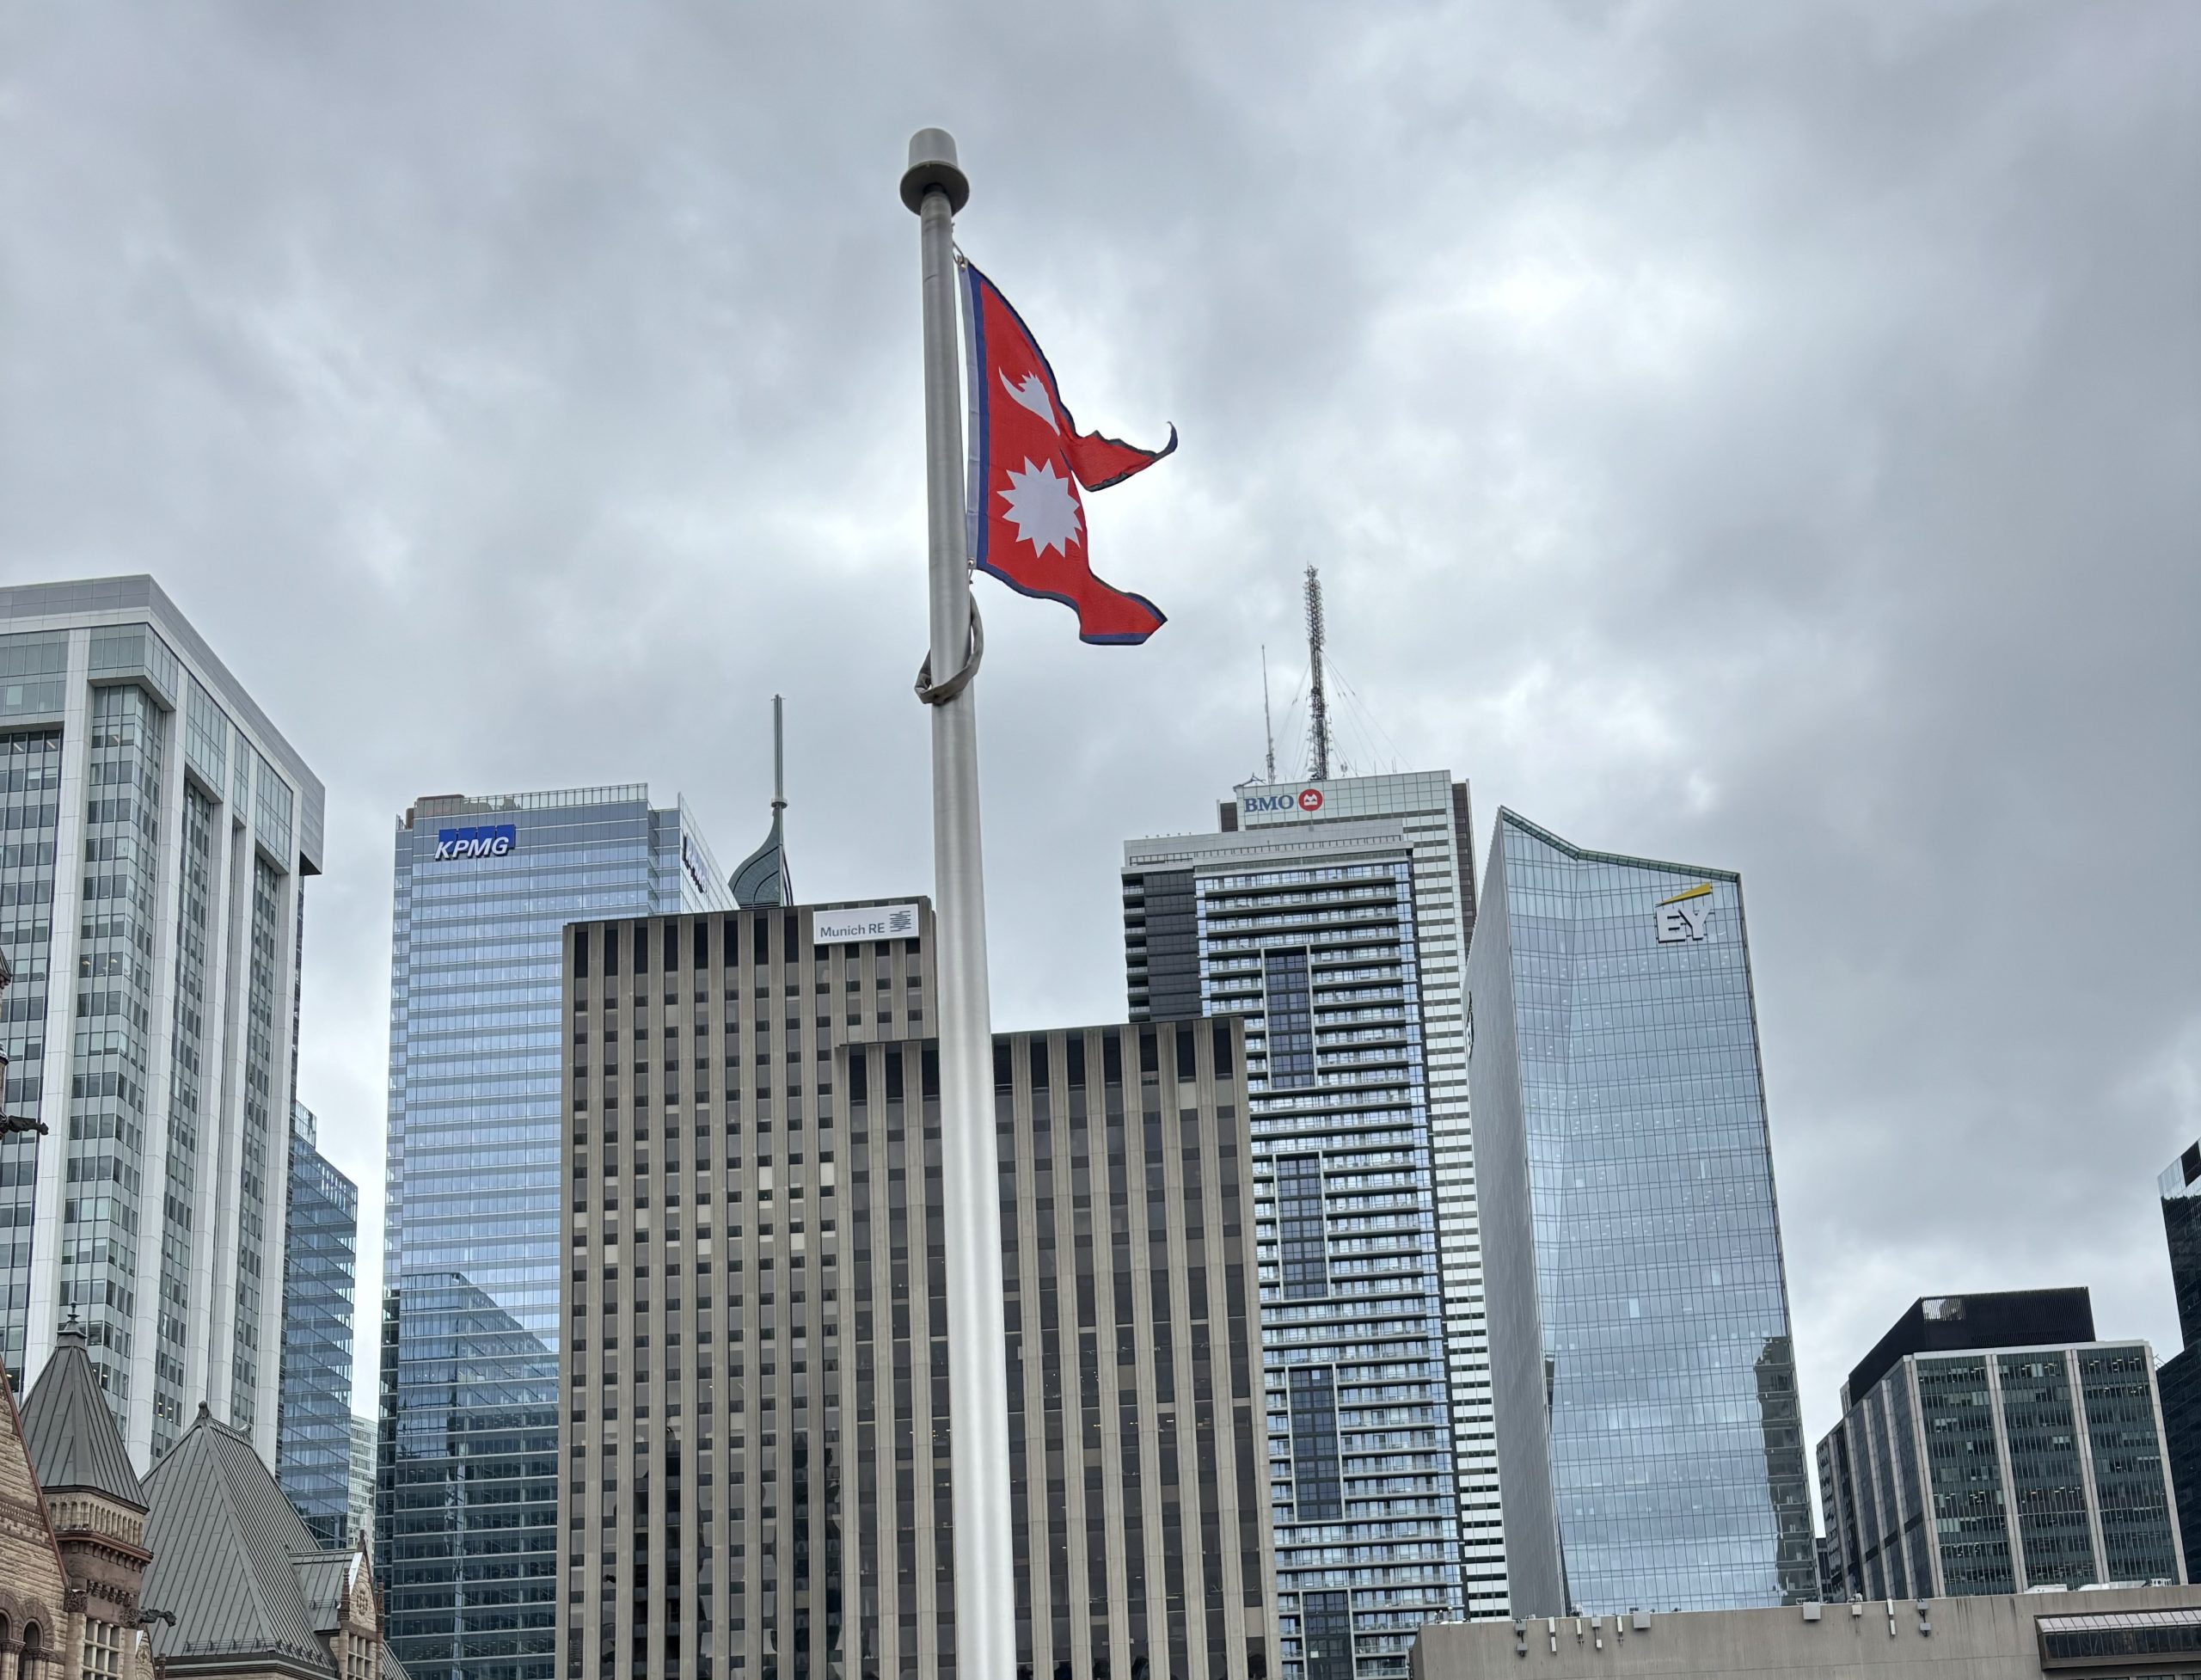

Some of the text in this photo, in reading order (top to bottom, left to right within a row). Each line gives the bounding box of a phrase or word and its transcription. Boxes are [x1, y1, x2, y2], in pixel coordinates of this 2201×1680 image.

[1244, 794, 1294, 812] BMO
[434, 837, 509, 859] KPMG
[820, 923, 885, 938] Munich RE
[1656, 905, 1712, 941] EY
